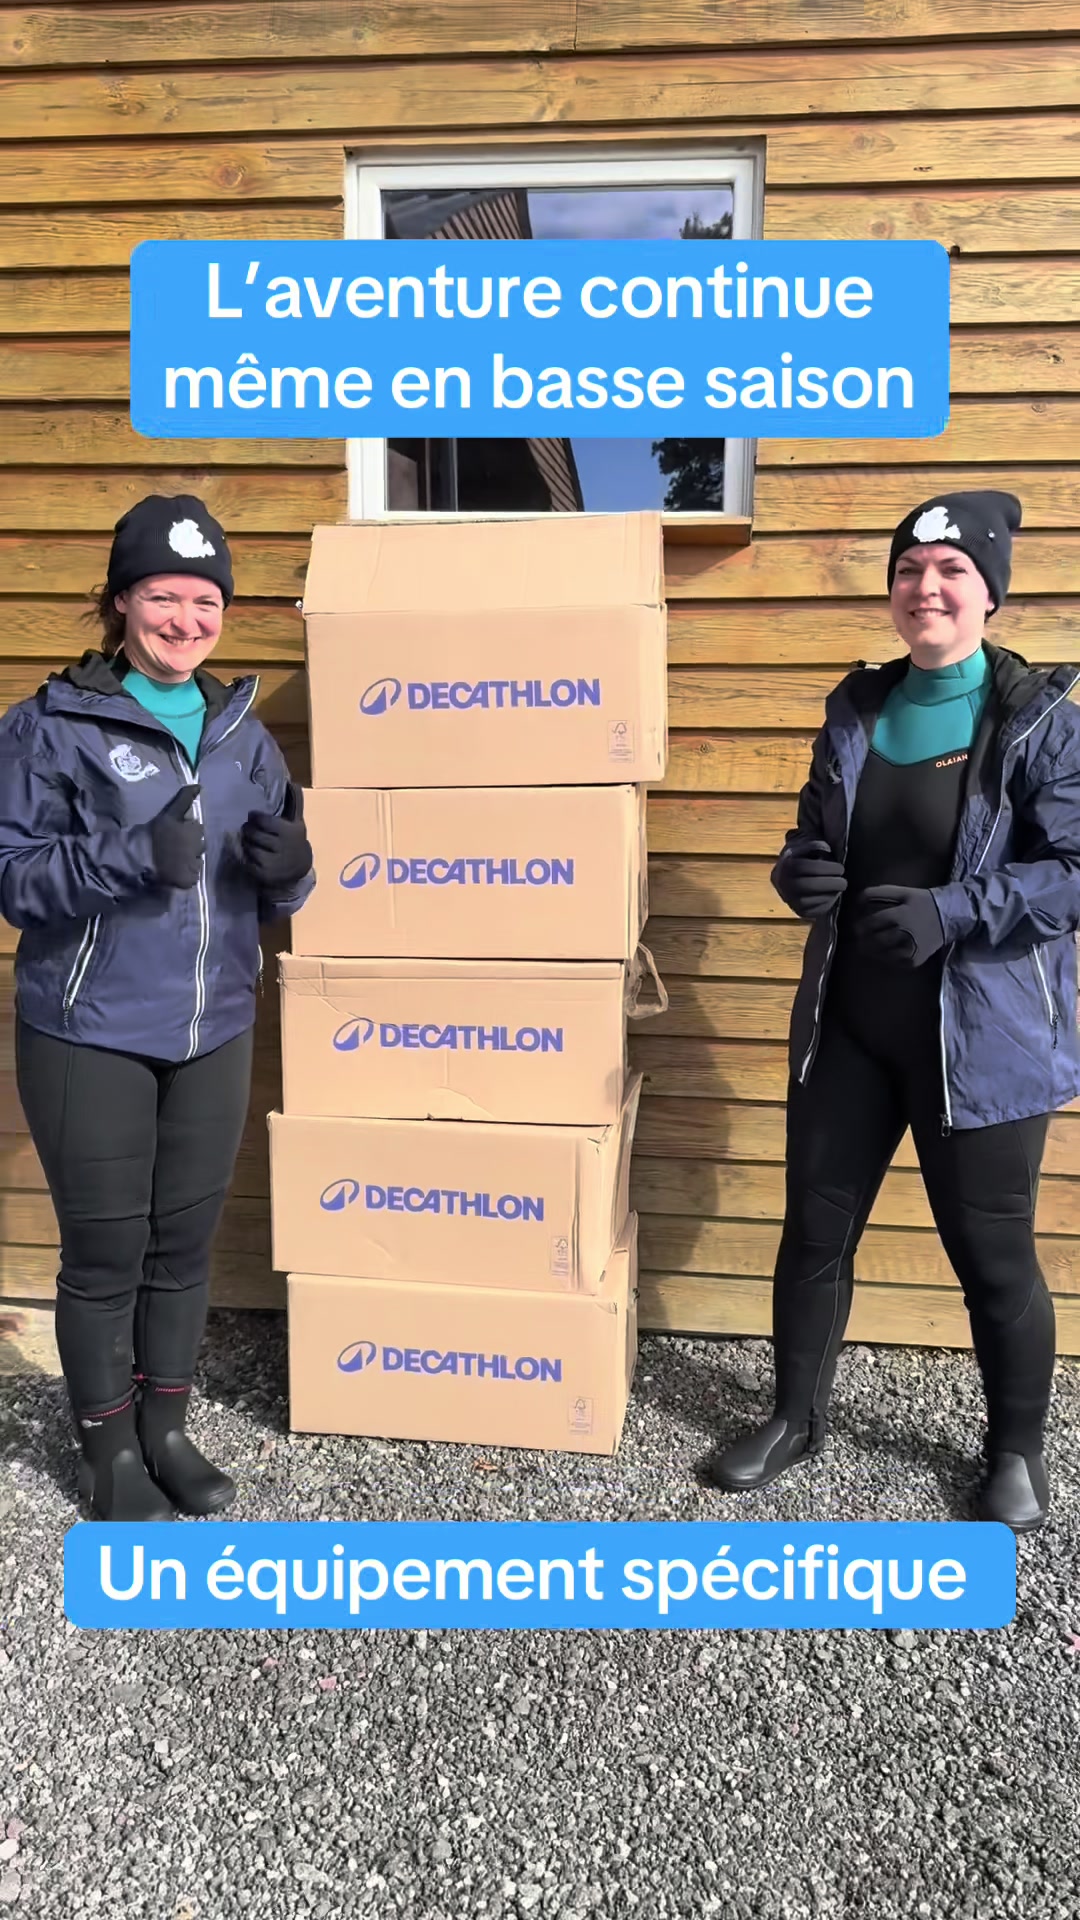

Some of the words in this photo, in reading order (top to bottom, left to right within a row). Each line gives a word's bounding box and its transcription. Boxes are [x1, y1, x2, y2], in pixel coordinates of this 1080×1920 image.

[407, 678, 601, 711] DECATHLON
[935, 753, 969, 768] OLAIAN
[387, 858, 574, 886] DECATHLON
[379, 1023, 563, 1052] DECATHLON
[364, 1184, 544, 1221] DECATHLON
[382, 1347, 562, 1382] DECATHLON
